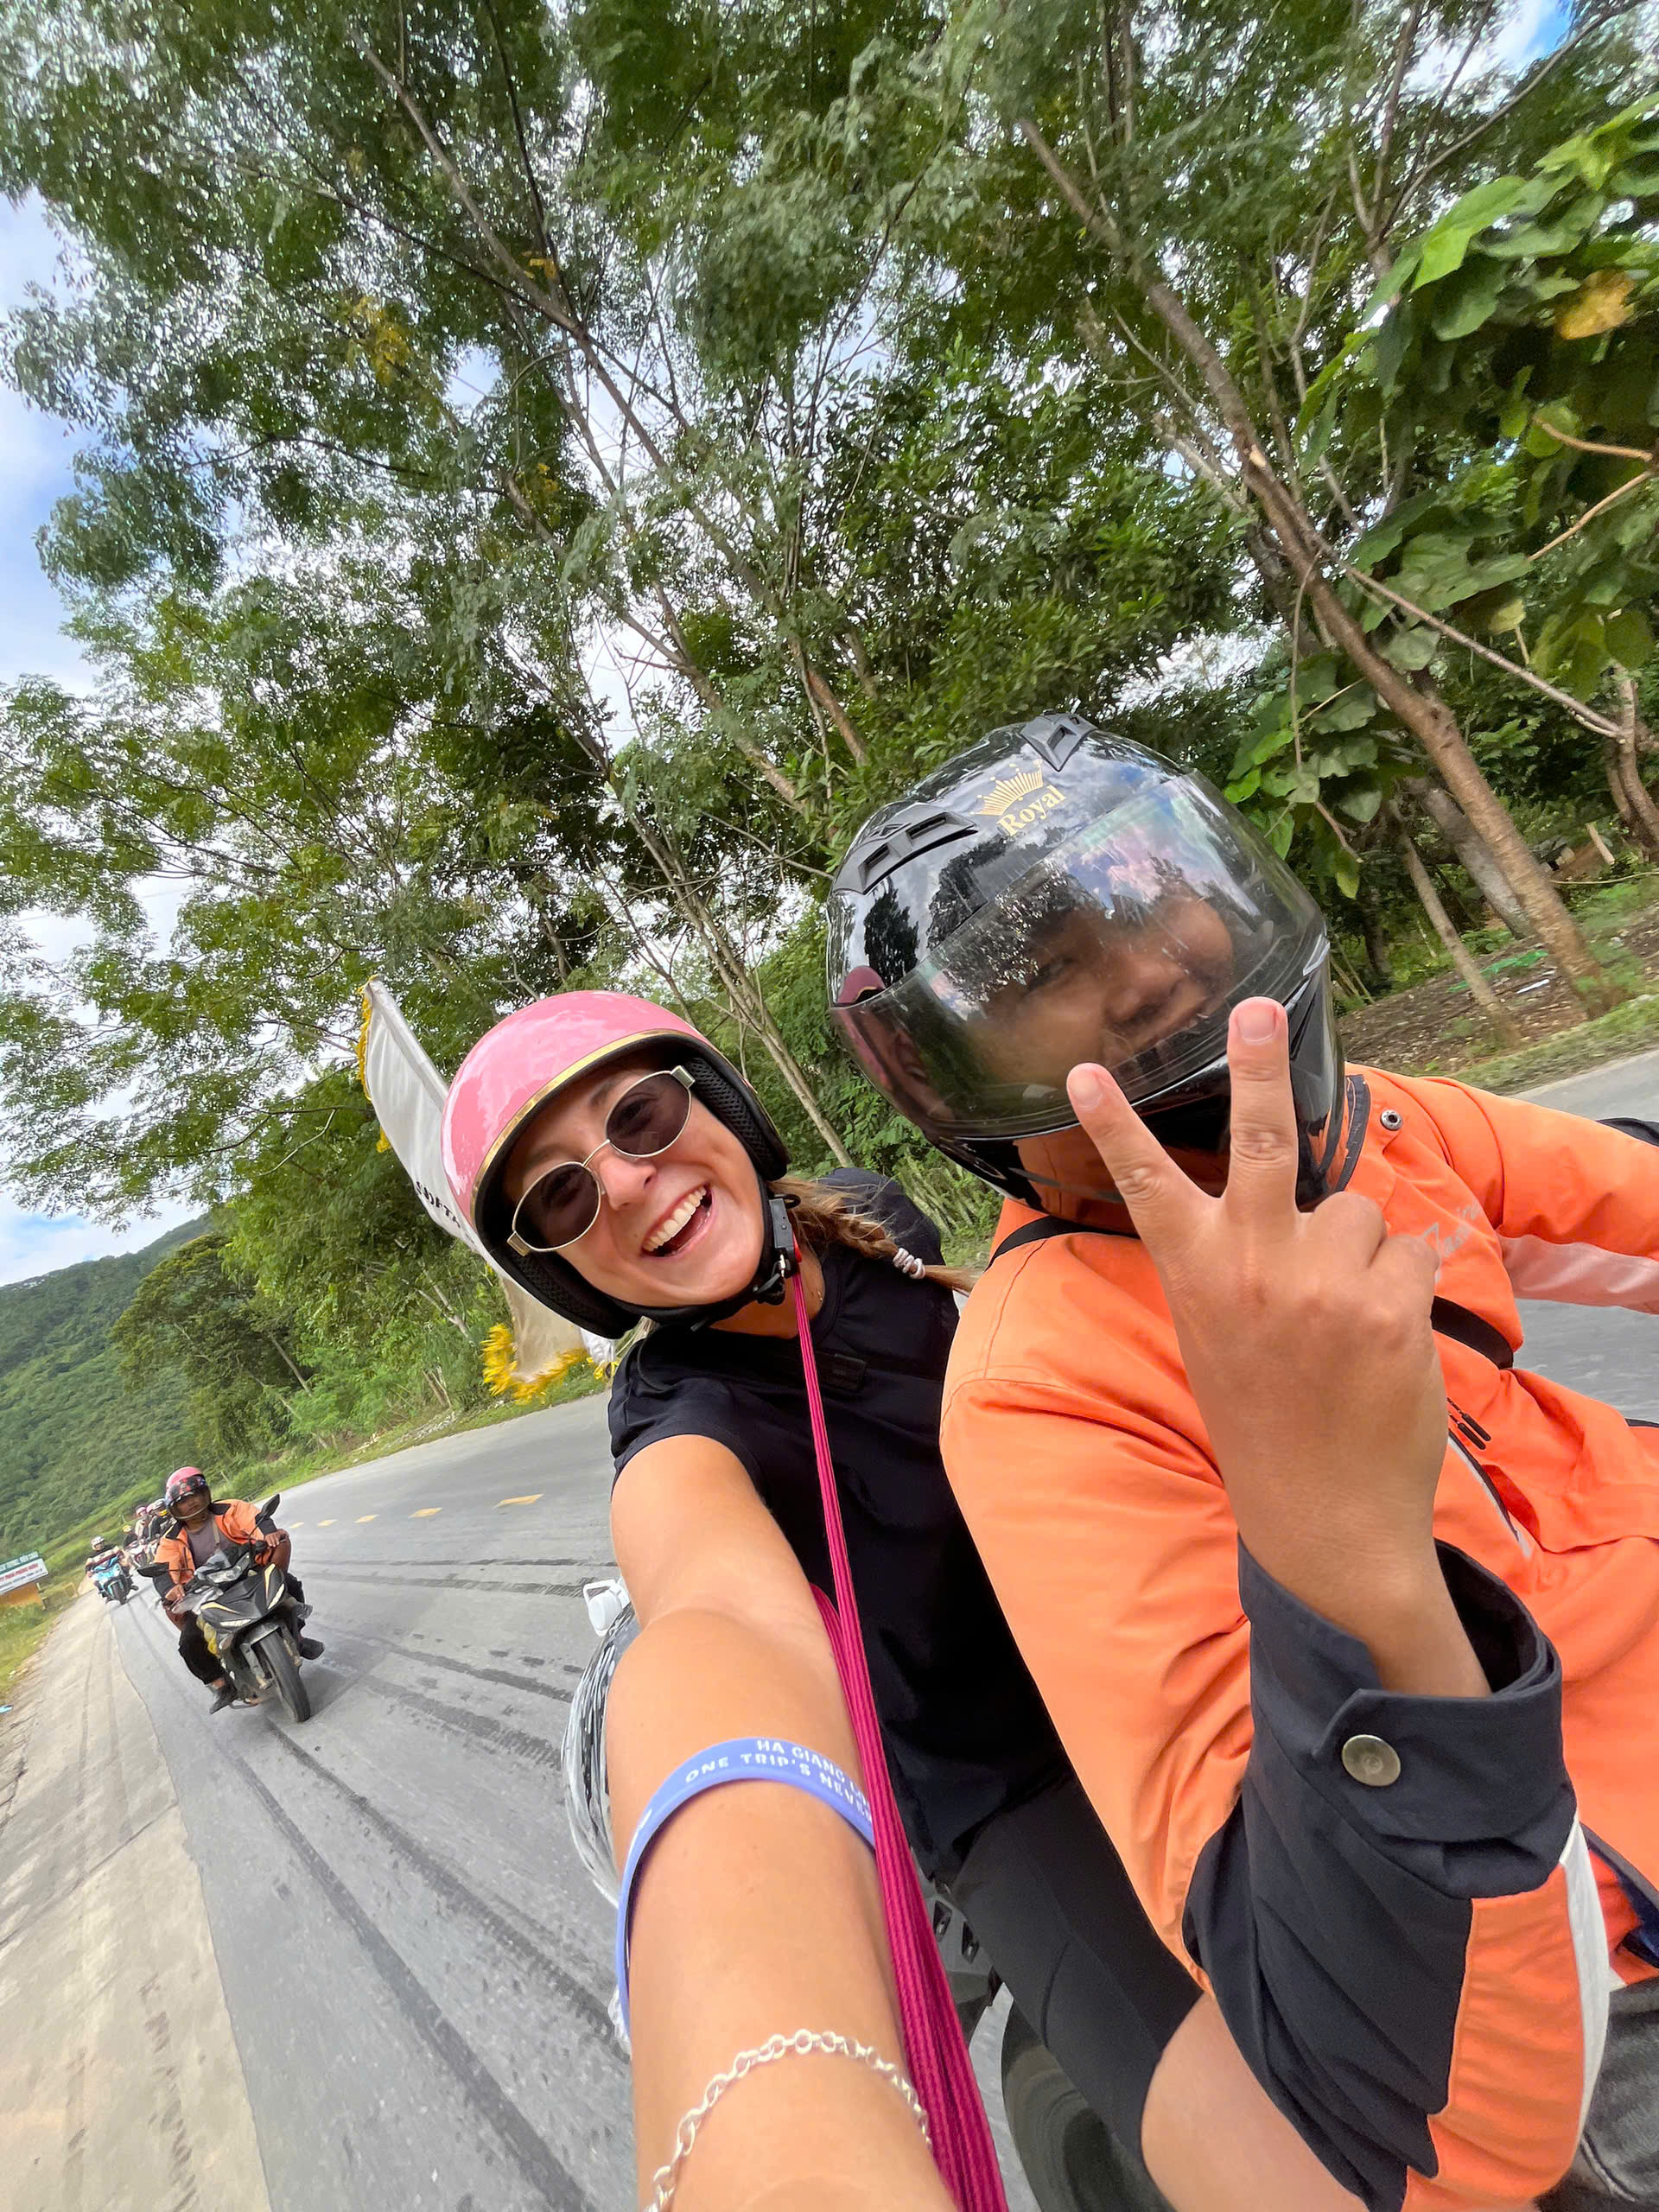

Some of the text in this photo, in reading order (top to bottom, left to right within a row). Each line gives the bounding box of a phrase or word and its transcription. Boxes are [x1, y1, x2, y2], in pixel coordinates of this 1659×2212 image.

[996, 785, 1065, 836] Royal
[757, 1739, 785, 1754] HA
[686, 1758, 729, 1783] ONE
[740, 1753, 810, 1777] TRIP'S
